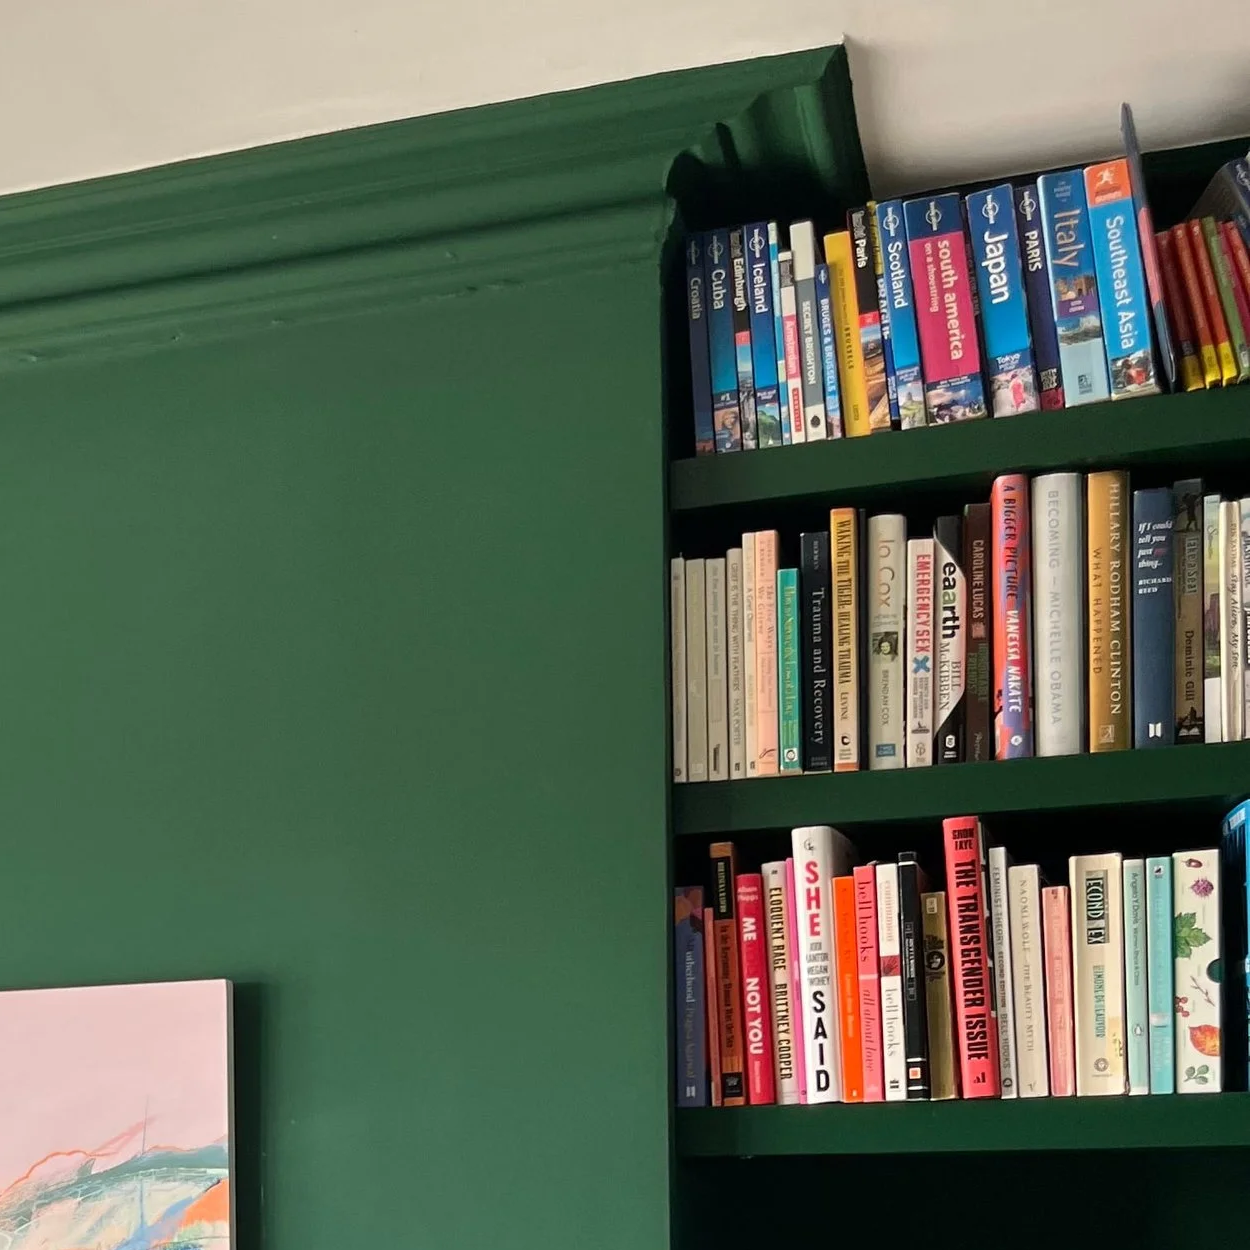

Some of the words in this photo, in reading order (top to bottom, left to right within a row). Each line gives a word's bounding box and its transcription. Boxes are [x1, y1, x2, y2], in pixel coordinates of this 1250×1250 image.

[855, 240, 867, 268] Paris
[924, 242, 933, 254] on
[1025, 231, 1040, 272] PARIS
[1053, 209, 1084, 267] Italy
[734, 258, 746, 311] Edinburgh
[888, 241, 908, 308] Scotland
[937, 240, 957, 288] south
[981, 231, 1010, 304] Japan
[1106, 216, 1132, 307] Southeast
[1120, 311, 1138, 349] Asia
[690, 278, 703, 319] Croatia
[711, 269, 727, 310] Cuba
[753, 263, 768, 313] Iceland
[927, 264, 940, 312] shoestring
[803, 301, 813, 334] SECRET
[820, 299, 832, 334] BRUGES
[944, 293, 964, 360] america
[785, 320, 798, 375] Amsterdam
[805, 338, 816, 384] BRIGHTON
[825, 346, 836, 392] BRUSSELS
[845, 327, 854, 369] BRUSSELS
[836, 520, 851, 557] WAKING
[1004, 498, 1017, 541] BIGGER
[1048, 491, 1059, 568] BECOMING
[1109, 484, 1119, 551] HILLARY
[837, 560, 850, 576] THE
[877, 540, 895, 558] Jo
[972, 540, 984, 587] CAROLINE
[1093, 547, 1102, 588] WHAT
[837, 578, 852, 609] TIGER:
[877, 567, 895, 608] Cox
[916, 554, 932, 627] EMERGENCY
[1006, 547, 1018, 600] PICTURE
[811, 588, 825, 642] Trauma
[942, 563, 959, 639] eaarth
[972, 588, 984, 618] LUCAS
[1109, 561, 1119, 632] RODHAM
[837, 611, 851, 645] HEALING
[917, 630, 930, 653] SEX
[1006, 610, 1020, 661] VANESSA
[1049, 591, 1061, 663] MICHELLE
[1093, 599, 1102, 674] HAPPENED
[813, 649, 825, 673] and
[838, 648, 851, 684] TRAUMA
[1184, 631, 1194, 677] Dominic
[881, 670, 890, 705] BRENDAN
[938, 642, 950, 710] McKIBBEN
[951, 661, 961, 691] BILL
[1007, 666, 1021, 713] NAKATE
[1110, 640, 1121, 715] CLINTON
[1185, 681, 1194, 701] Gill
[811, 679, 827, 745] Recovery
[881, 707, 890, 726] COX
[1050, 671, 1063, 725] OBAMA
[955, 860, 978, 888] THE
[992, 867, 1002, 908] FEMINIST
[770, 887, 784, 940] ELOQUENT
[806, 861, 822, 936] SHE
[858, 882, 870, 912] bell
[742, 917, 756, 941] ME
[858, 916, 872, 962] hooks
[994, 913, 1004, 946] THEORY
[773, 945, 786, 970] RAGE
[957, 894, 986, 1008] TRANSGENDER
[746, 977, 760, 1013] NOT
[776, 984, 790, 1034] BRITTNEY
[885, 988, 898, 1013] bell
[748, 1016, 763, 1054] YOU
[812, 990, 830, 1092] SAID
[886, 1017, 900, 1057] hooks
[966, 1013, 988, 1060] ISSUE
[1000, 1014, 1009, 1034] BELL
[779, 1039, 792, 1080] COOPER
[1001, 1038, 1011, 1068] HOOKS
